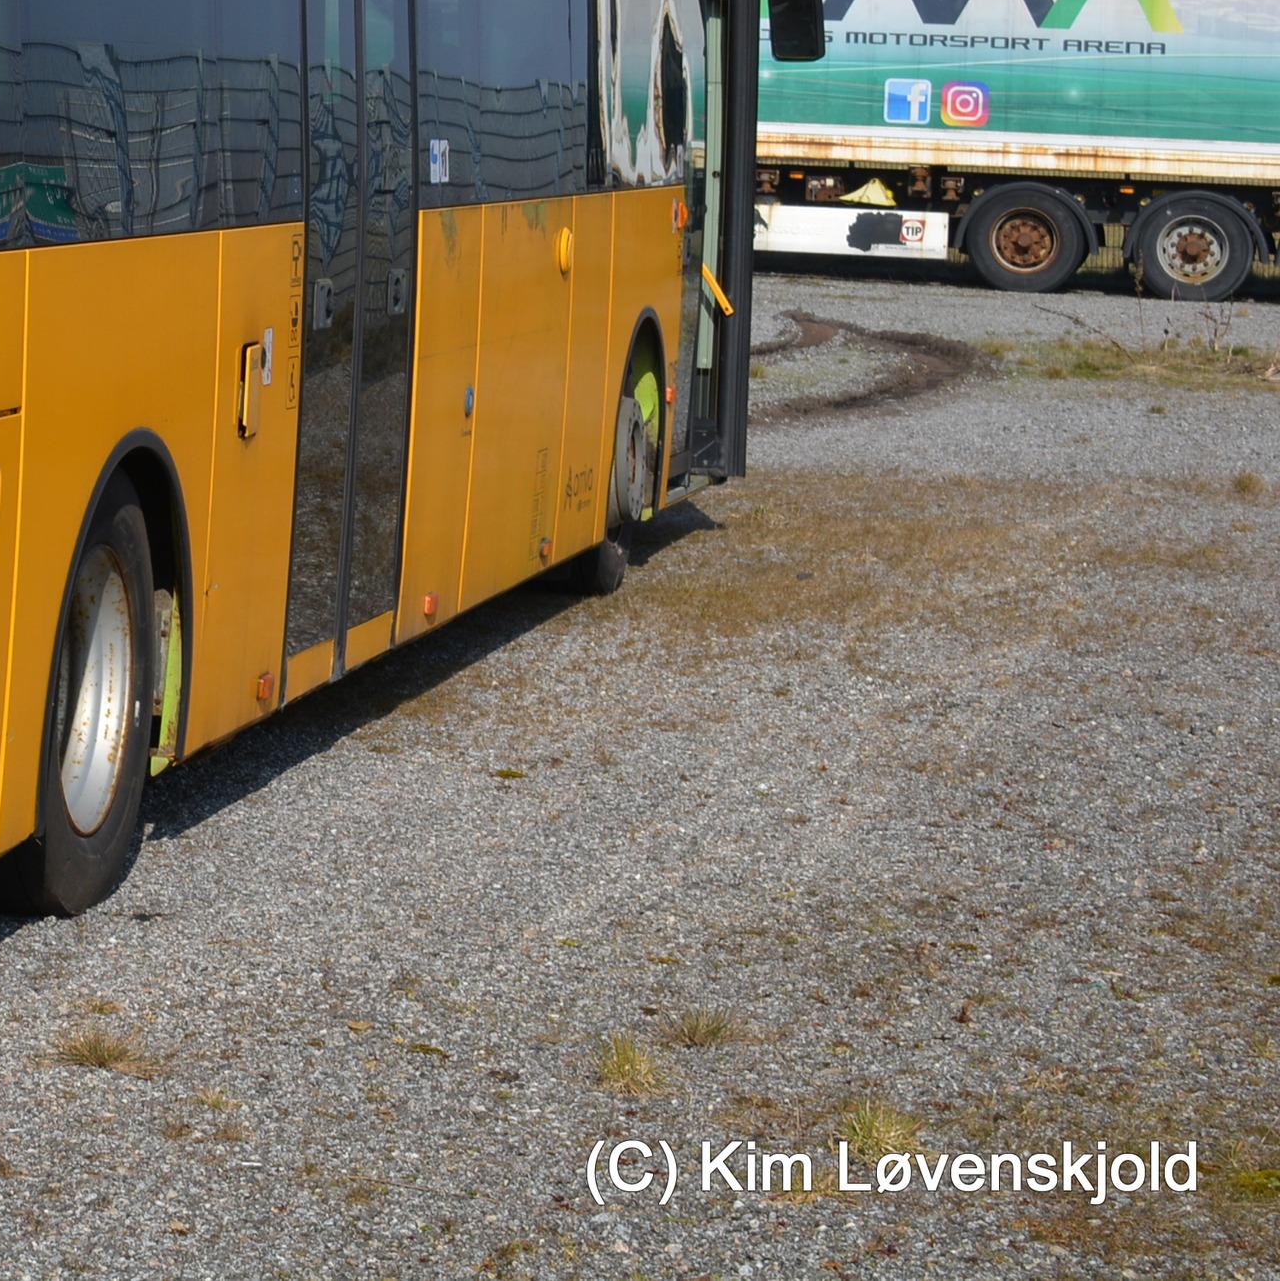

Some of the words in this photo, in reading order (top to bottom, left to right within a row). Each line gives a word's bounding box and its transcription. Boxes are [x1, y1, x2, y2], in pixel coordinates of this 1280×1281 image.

[845, 30, 1051, 52] MOTORSPORT
[1063, 38, 1167, 55] ARENA
[904, 226, 922, 237] TIP
